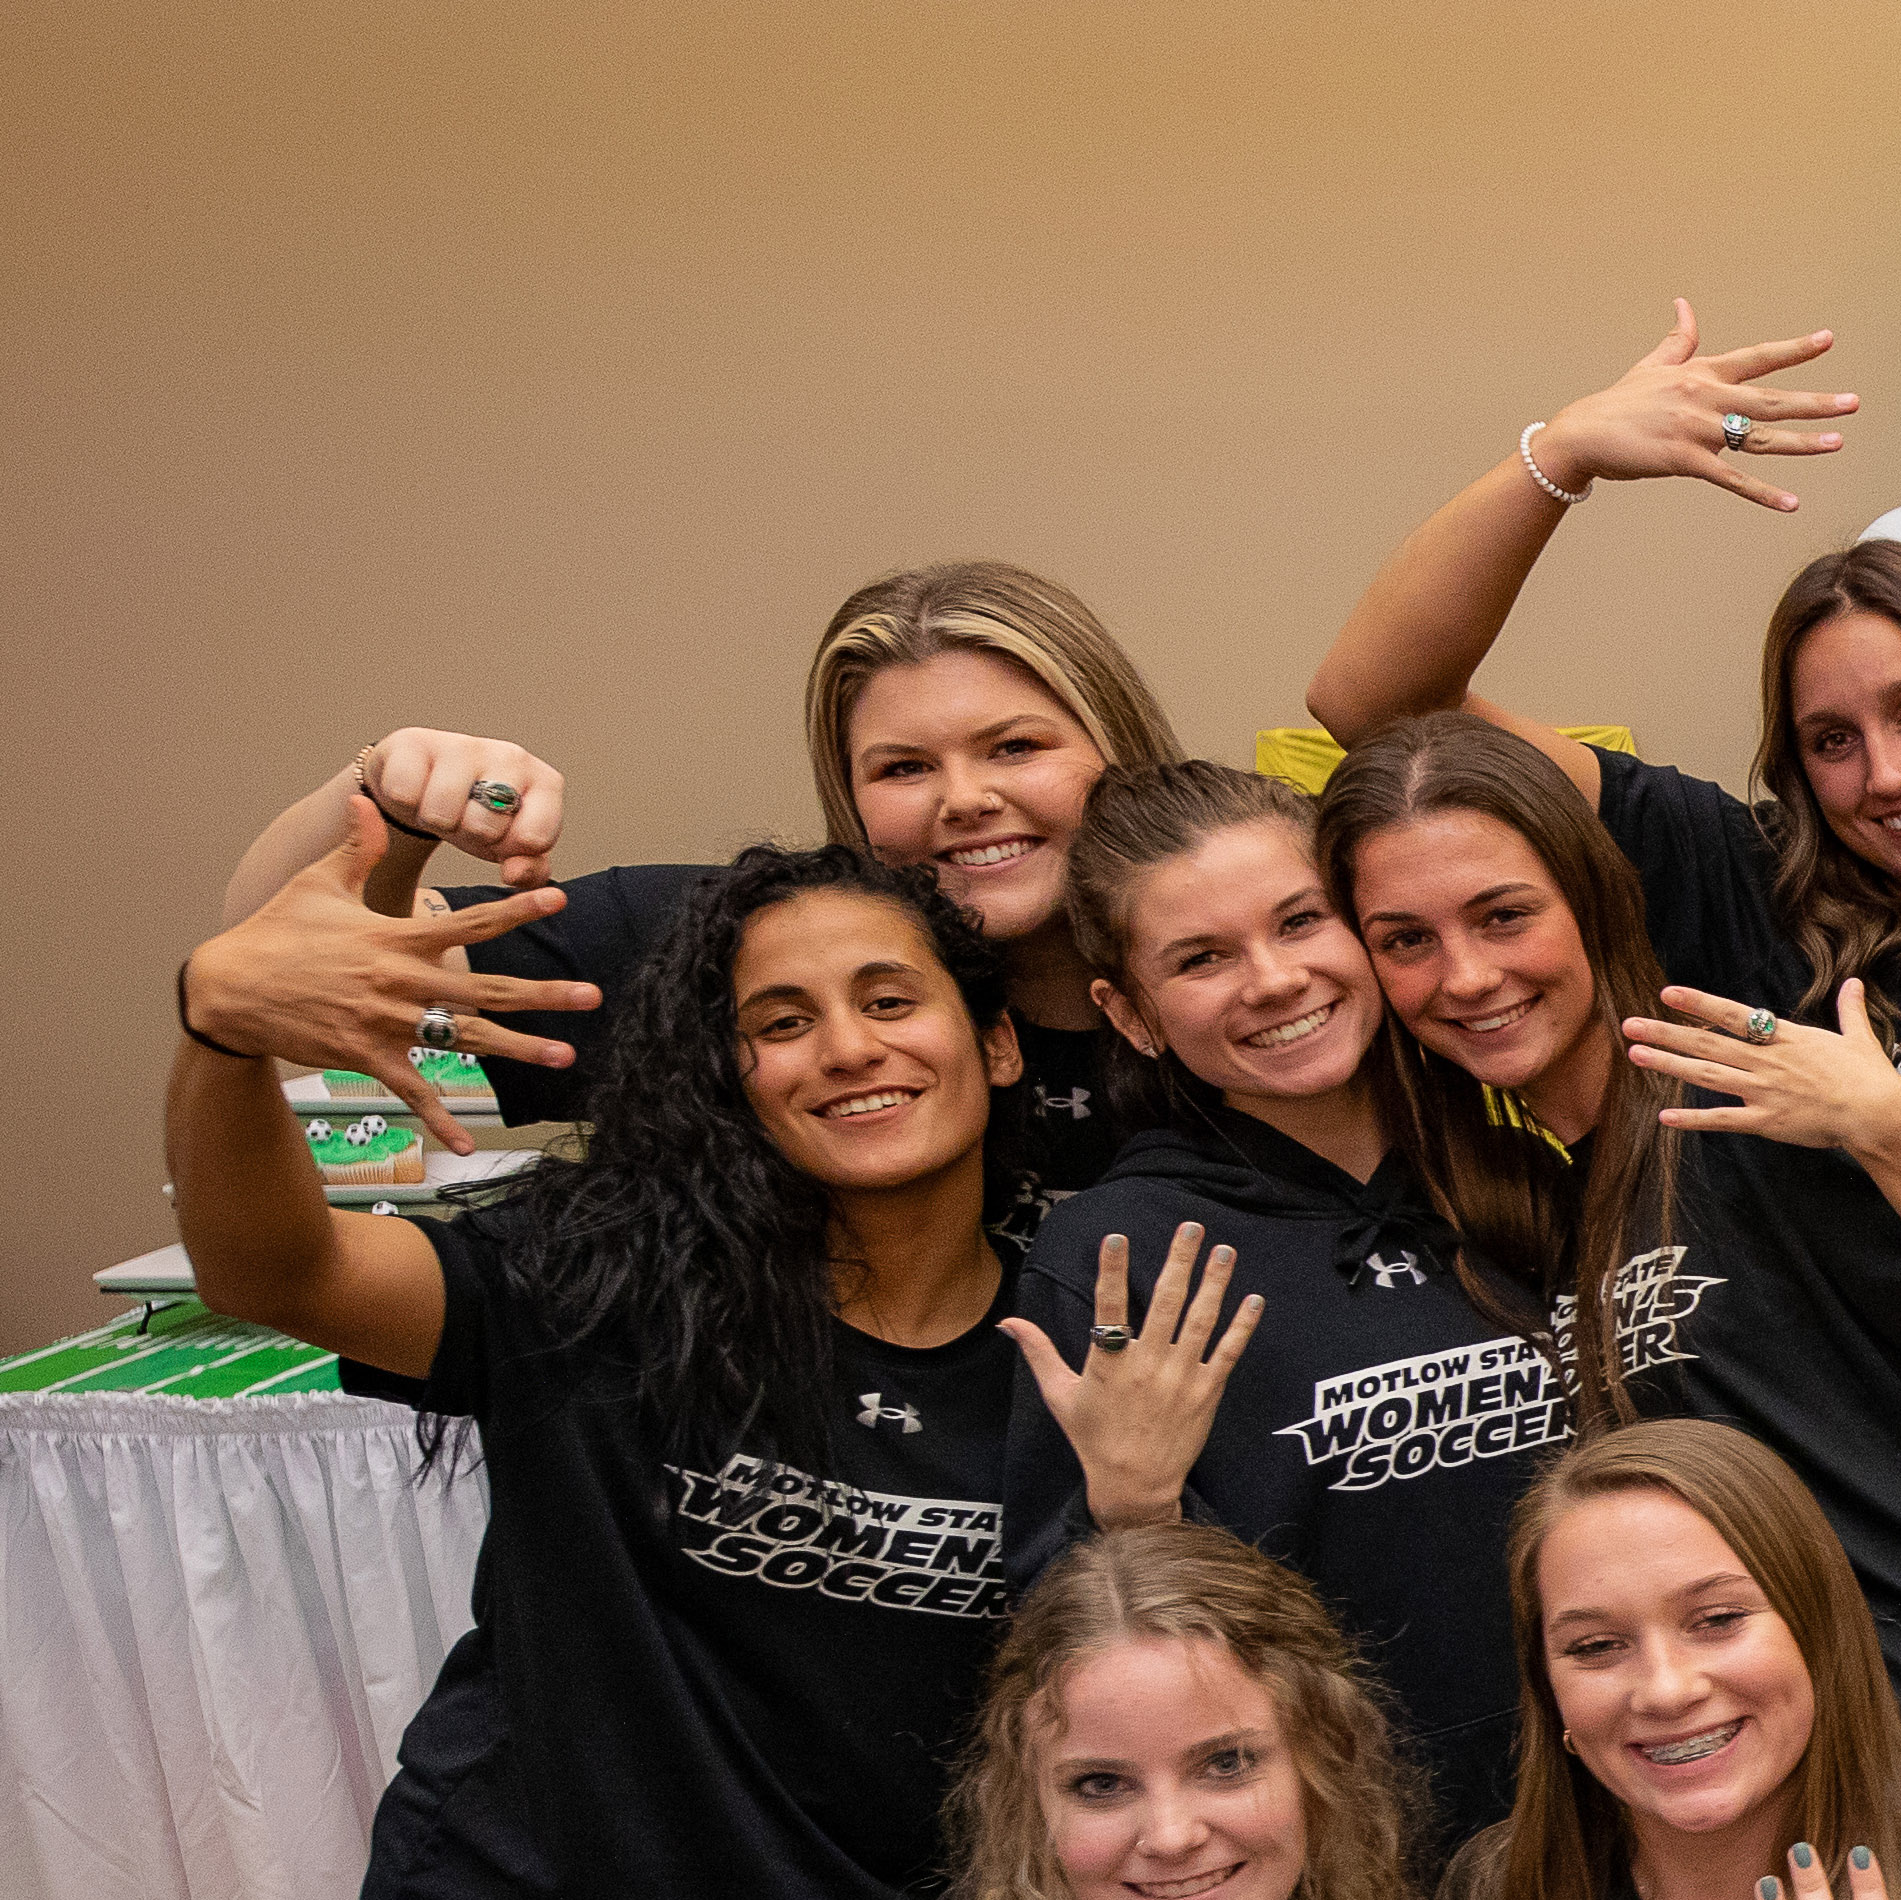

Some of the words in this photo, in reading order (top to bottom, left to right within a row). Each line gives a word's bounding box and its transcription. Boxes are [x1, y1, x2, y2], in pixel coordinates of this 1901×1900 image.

[1273, 1362, 1560, 1464] WOMEN
[1322, 1354, 1470, 1411] MOTLOW
[1480, 1343, 1537, 1371] STA
[668, 1468, 1002, 1581] WOMEN
[917, 1507, 999, 1534] STA
